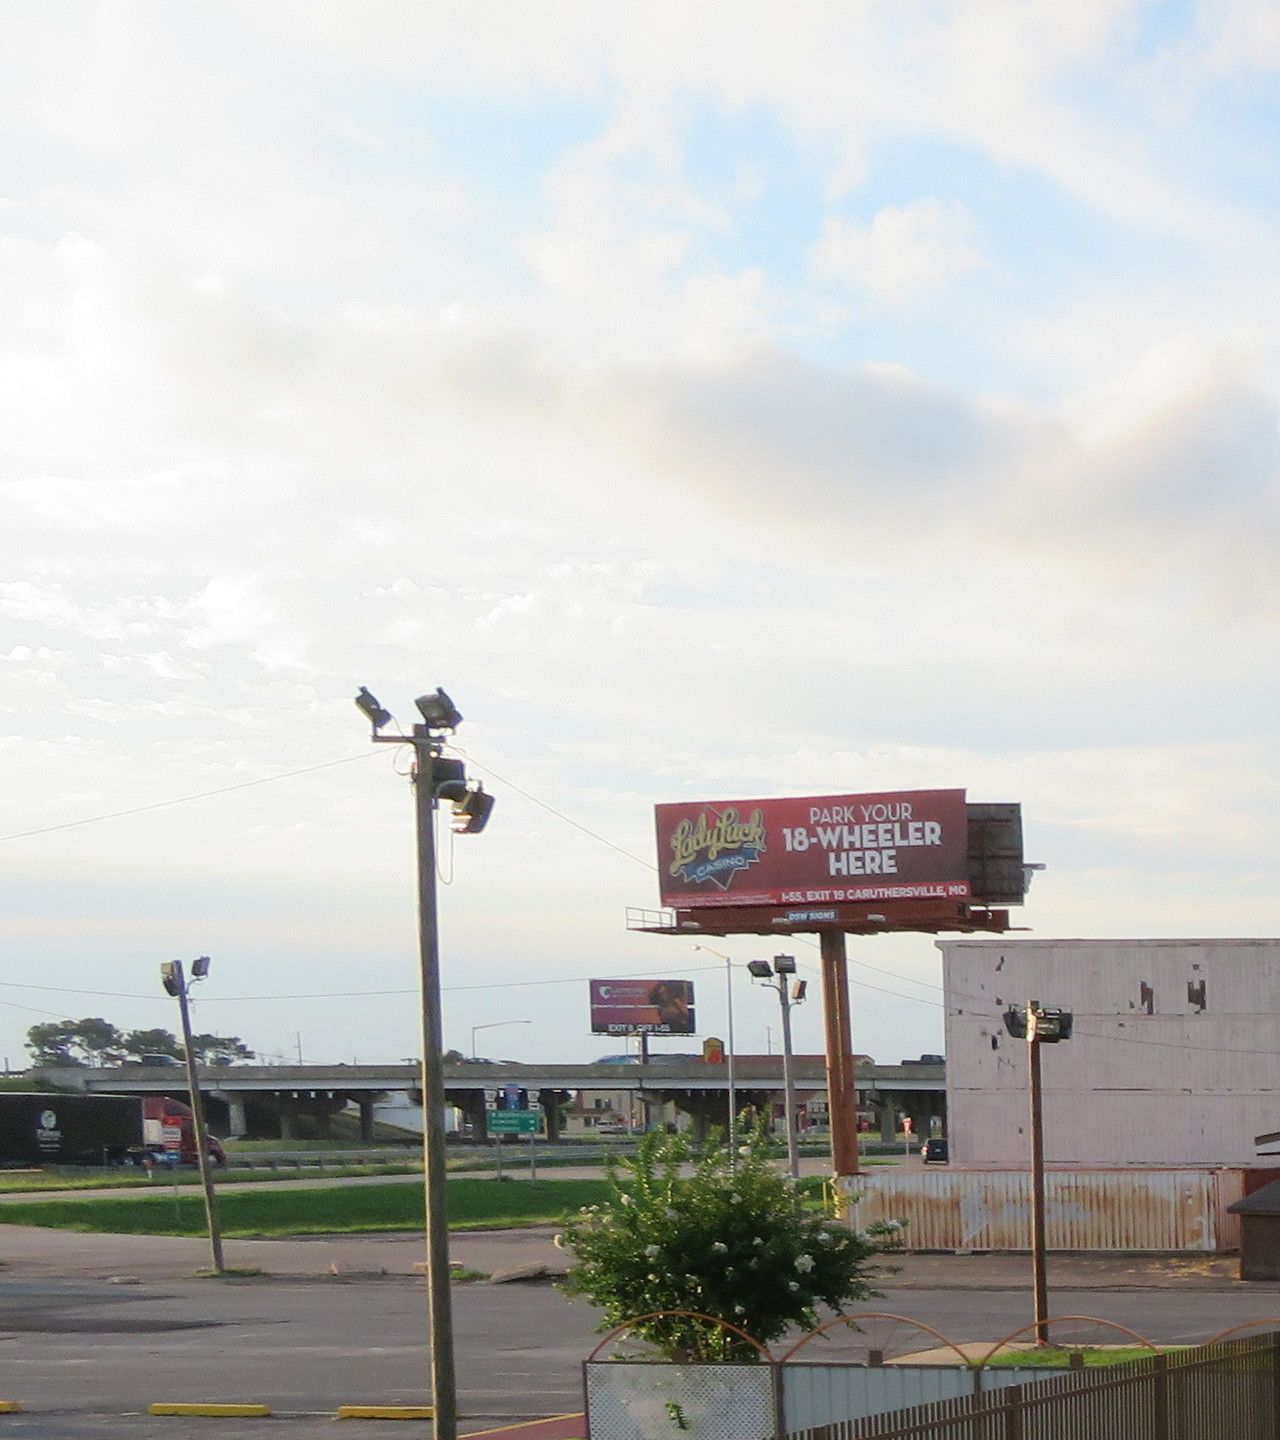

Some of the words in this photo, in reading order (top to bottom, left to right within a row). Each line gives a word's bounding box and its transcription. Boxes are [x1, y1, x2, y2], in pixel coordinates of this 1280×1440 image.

[810, 805, 857, 824] PARK
[860, 802, 912, 822] YOUR
[782, 821, 942, 851] 18-WHEELER
[697, 856, 745, 876] CASINO
[828, 849, 898, 876] HERE
[806, 889, 832, 901] EXIT
[833, 889, 845, 900] 19
[948, 885, 968, 896] MO
[608, 1023, 626, 1032] EXIT
